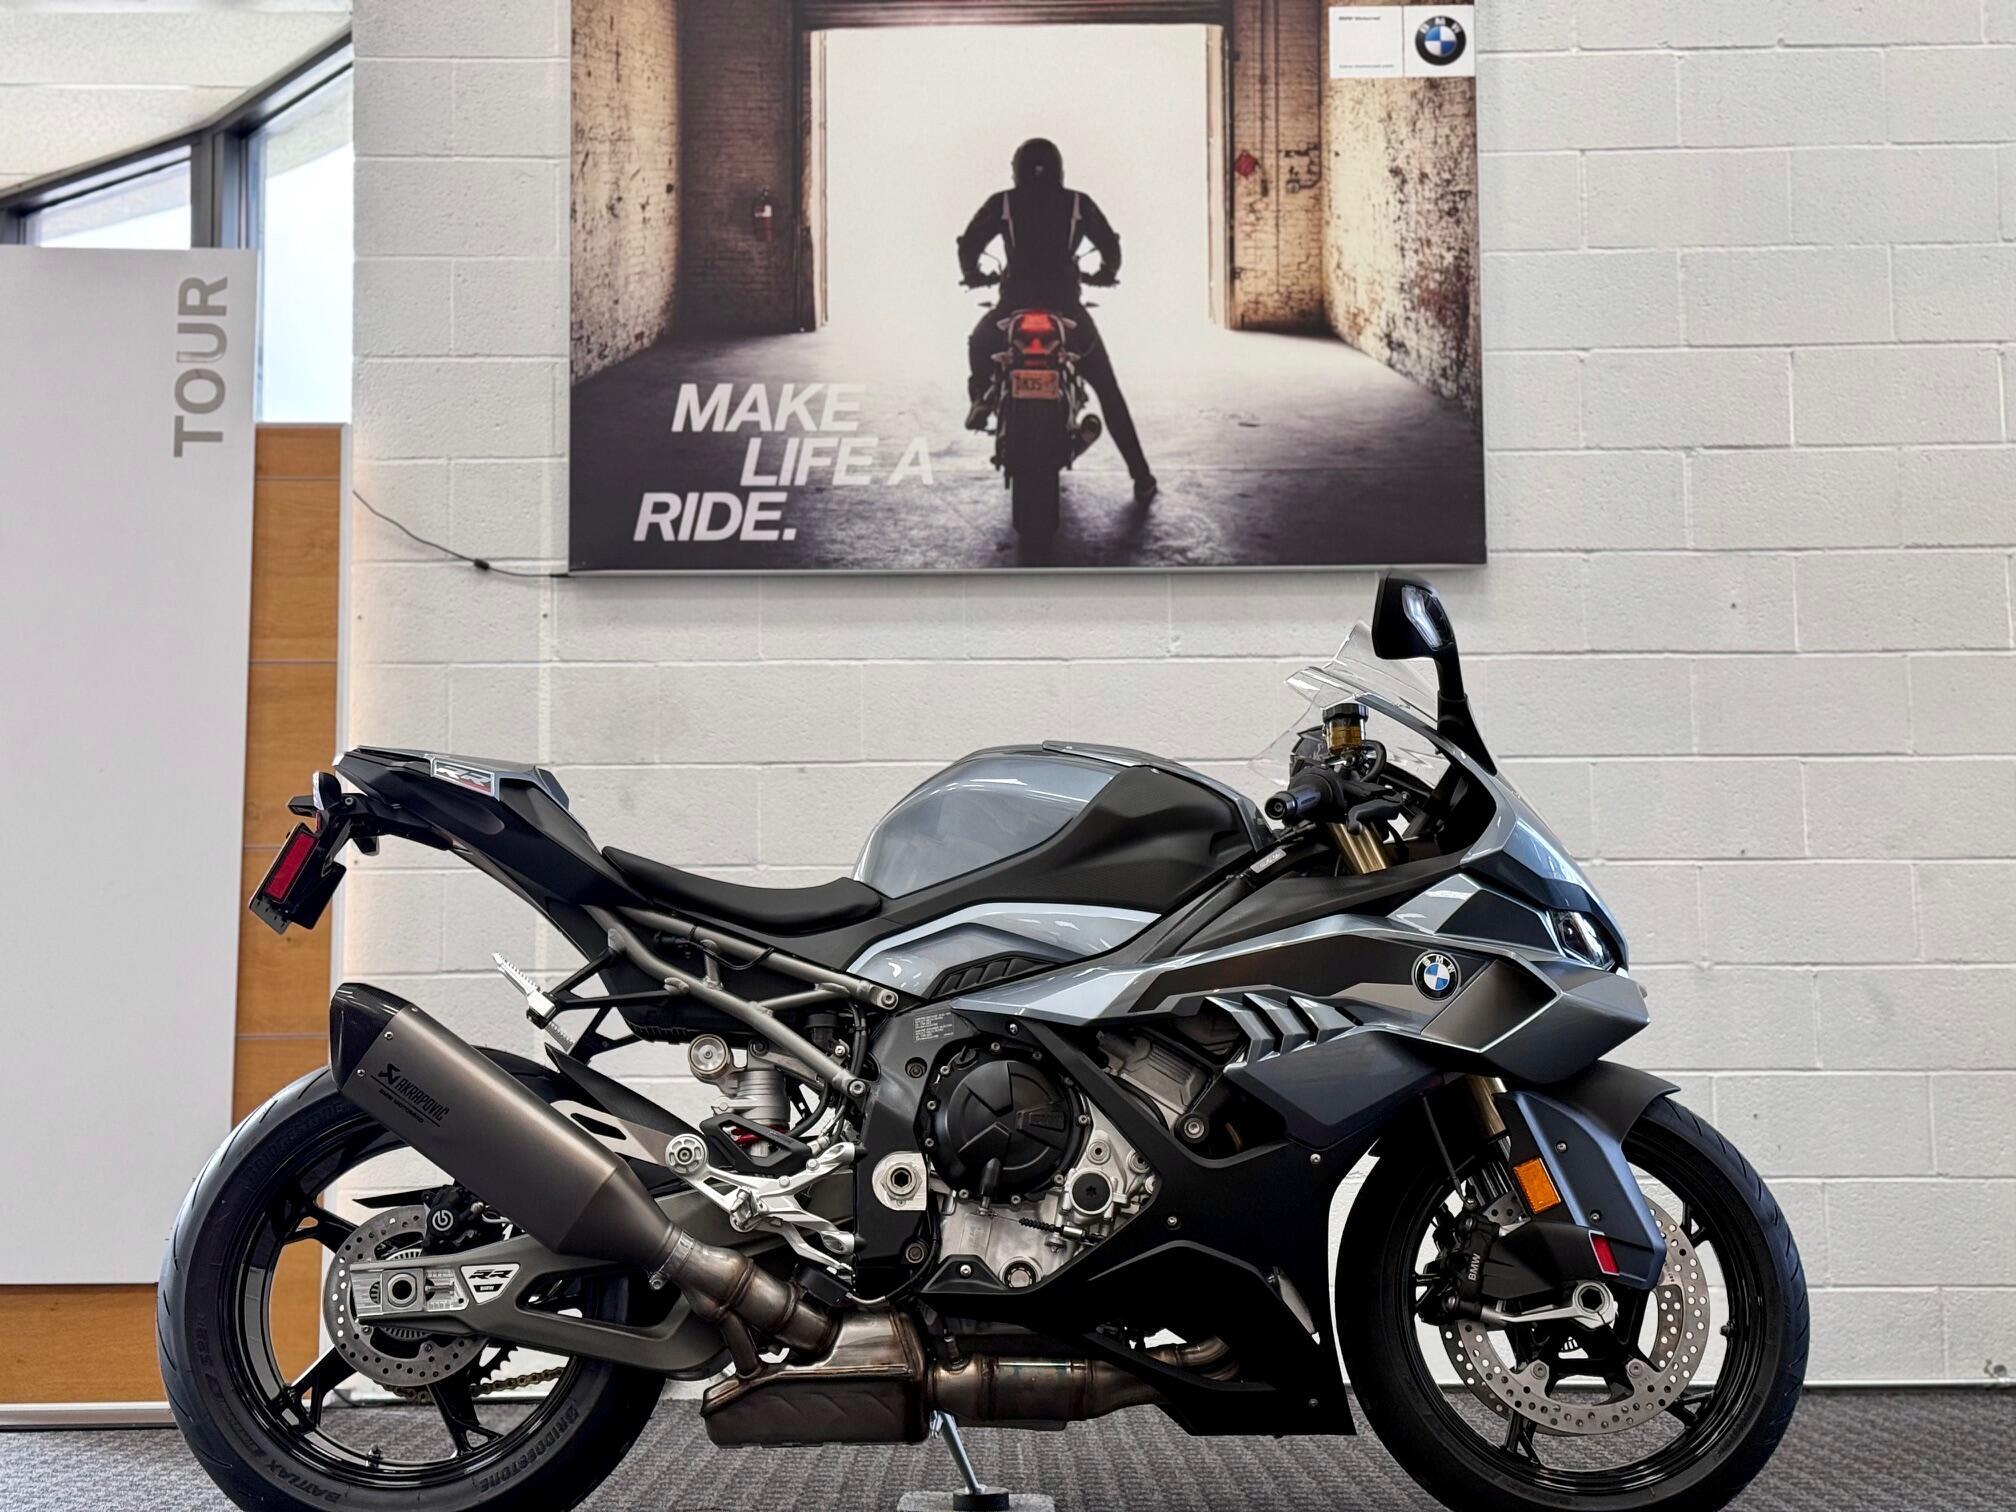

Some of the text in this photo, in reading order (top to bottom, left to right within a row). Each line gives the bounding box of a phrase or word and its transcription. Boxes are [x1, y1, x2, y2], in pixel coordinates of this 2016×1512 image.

[174, 276, 228, 458] TOUR
[672, 383, 866, 432] MAKE
[740, 437, 934, 486] LIFE A
[633, 492, 797, 541] RIDE.
[1468, 1253, 1481, 1281] BMW
[479, 1404, 580, 1494] BRIDGESTONE
[265, 1459, 342, 1502] BATTLAX
